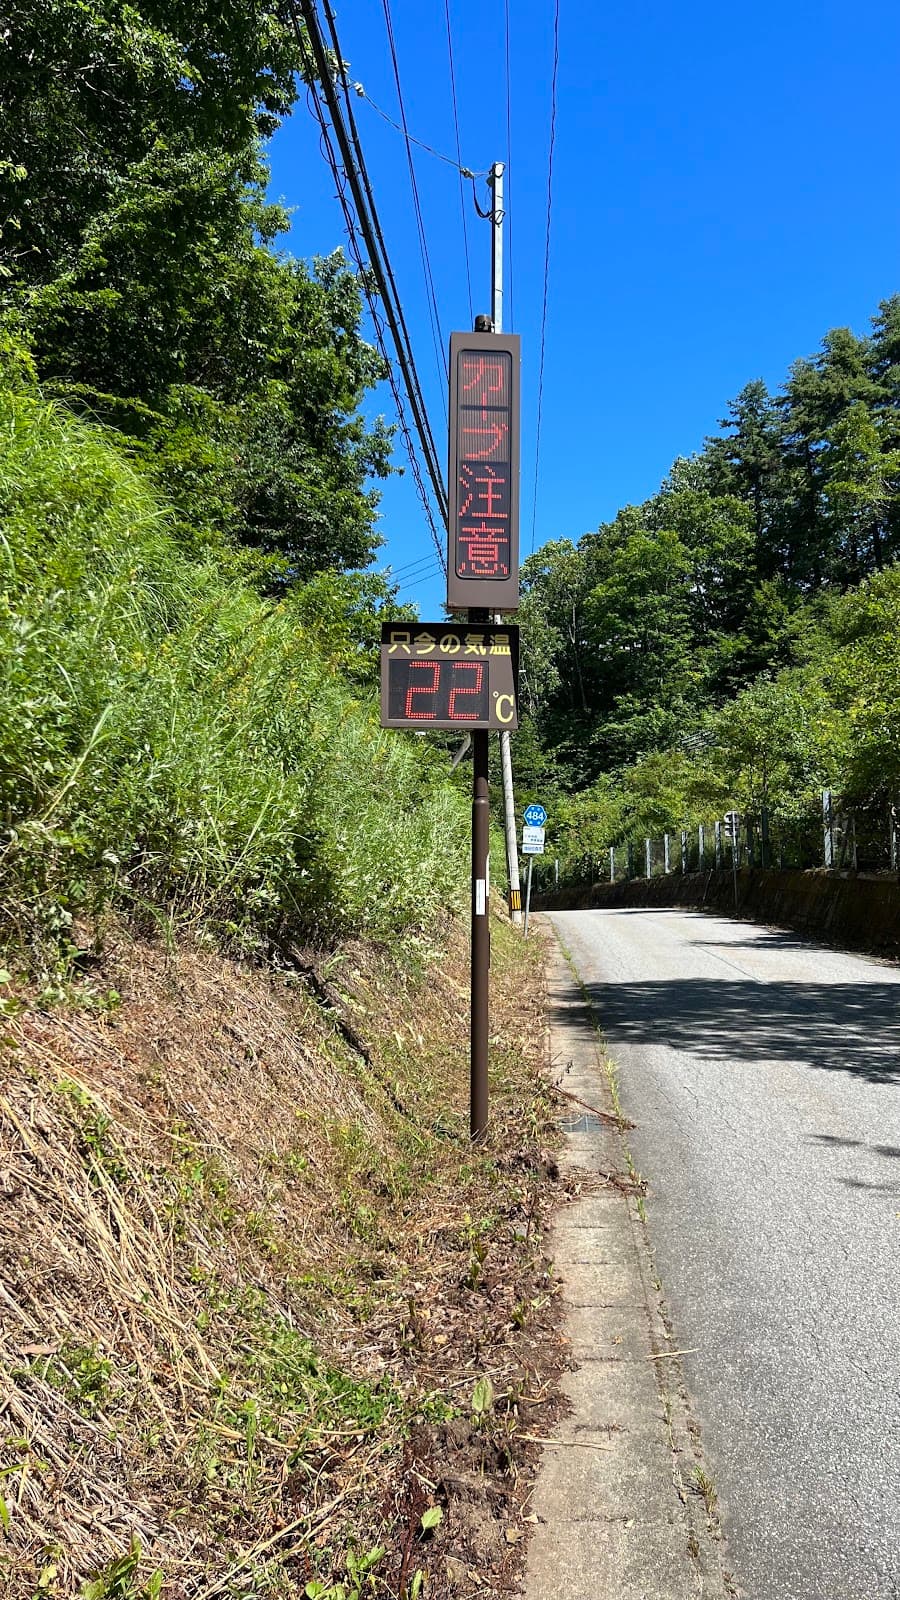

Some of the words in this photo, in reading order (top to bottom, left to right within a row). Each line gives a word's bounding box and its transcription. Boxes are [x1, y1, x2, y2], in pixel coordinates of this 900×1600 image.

[458, 357, 508, 575] カーブ注意
[388, 631, 511, 655] 只今の気温
[405, 661, 483, 719] 22
[526, 811, 544, 821] 484
